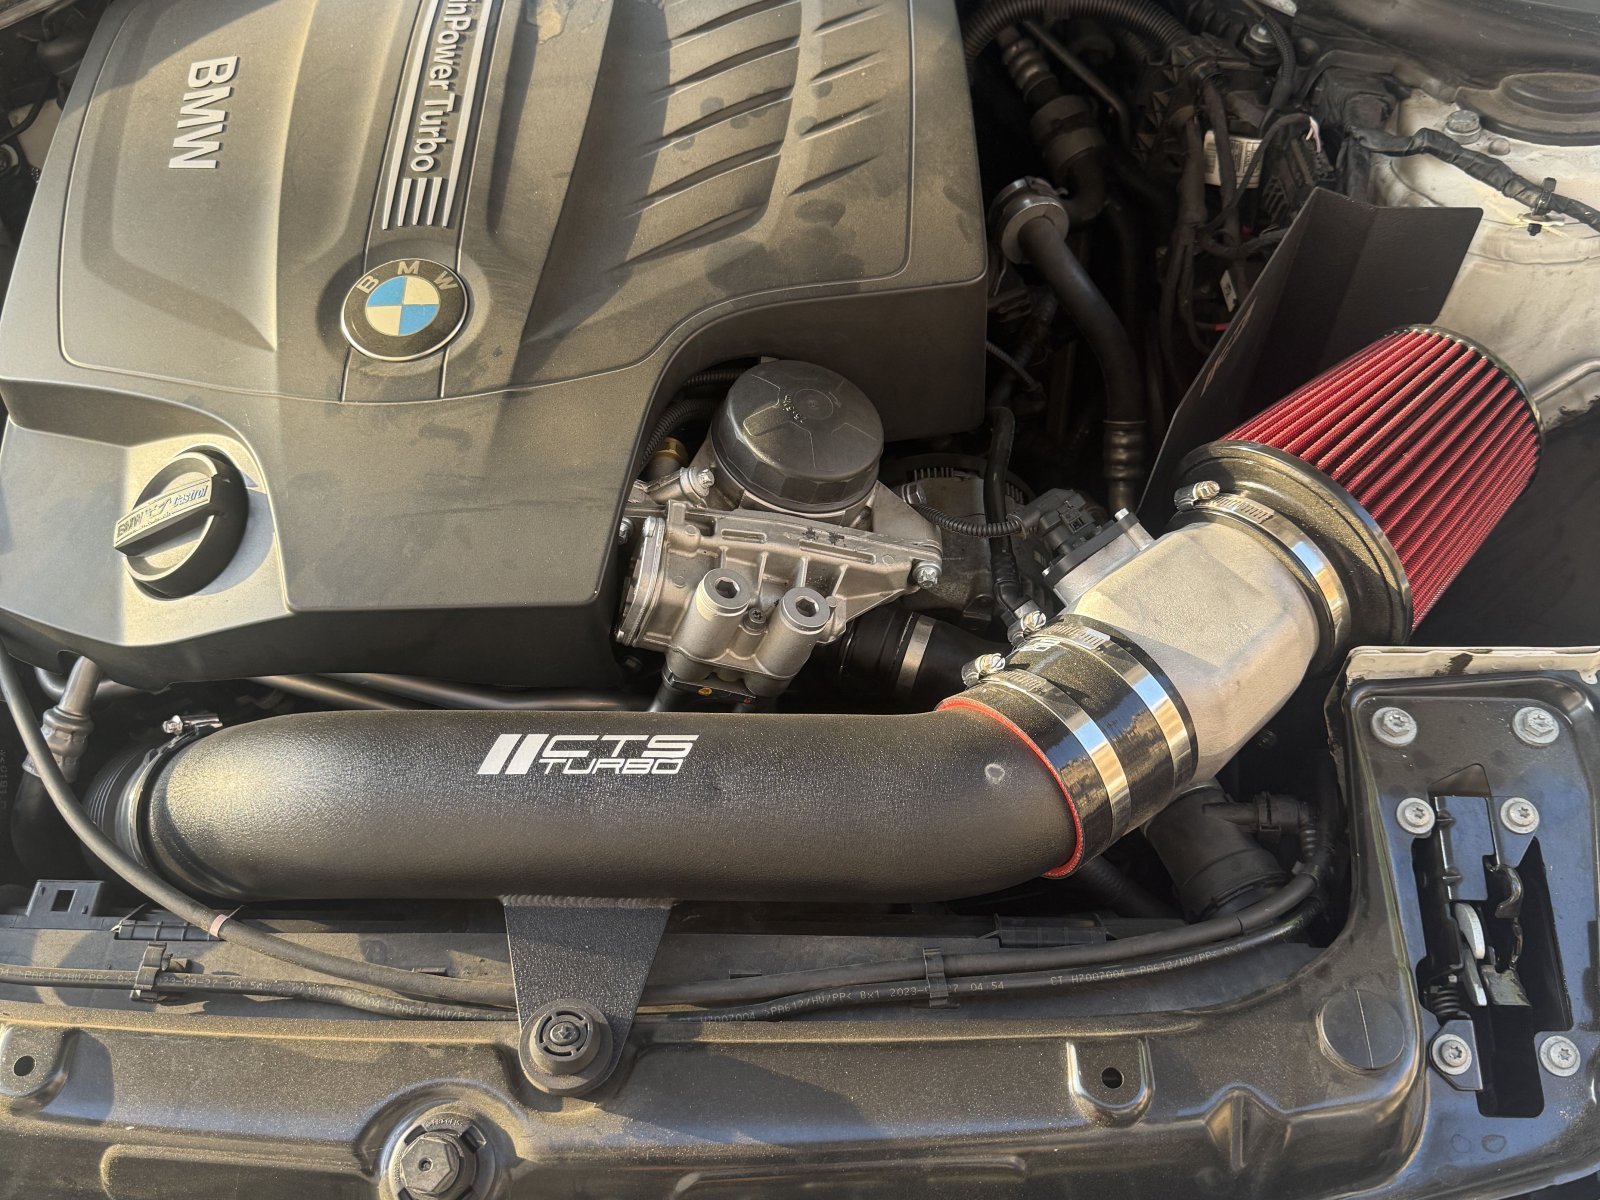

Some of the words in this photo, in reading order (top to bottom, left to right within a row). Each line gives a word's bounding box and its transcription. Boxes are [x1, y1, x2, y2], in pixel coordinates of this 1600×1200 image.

[169, 56, 238, 170] BMW
[410, 93, 455, 172] Turbo
[356, 260, 458, 294] BMW
[541, 734, 700, 758] CTS
[538, 758, 684, 775] TURBO
